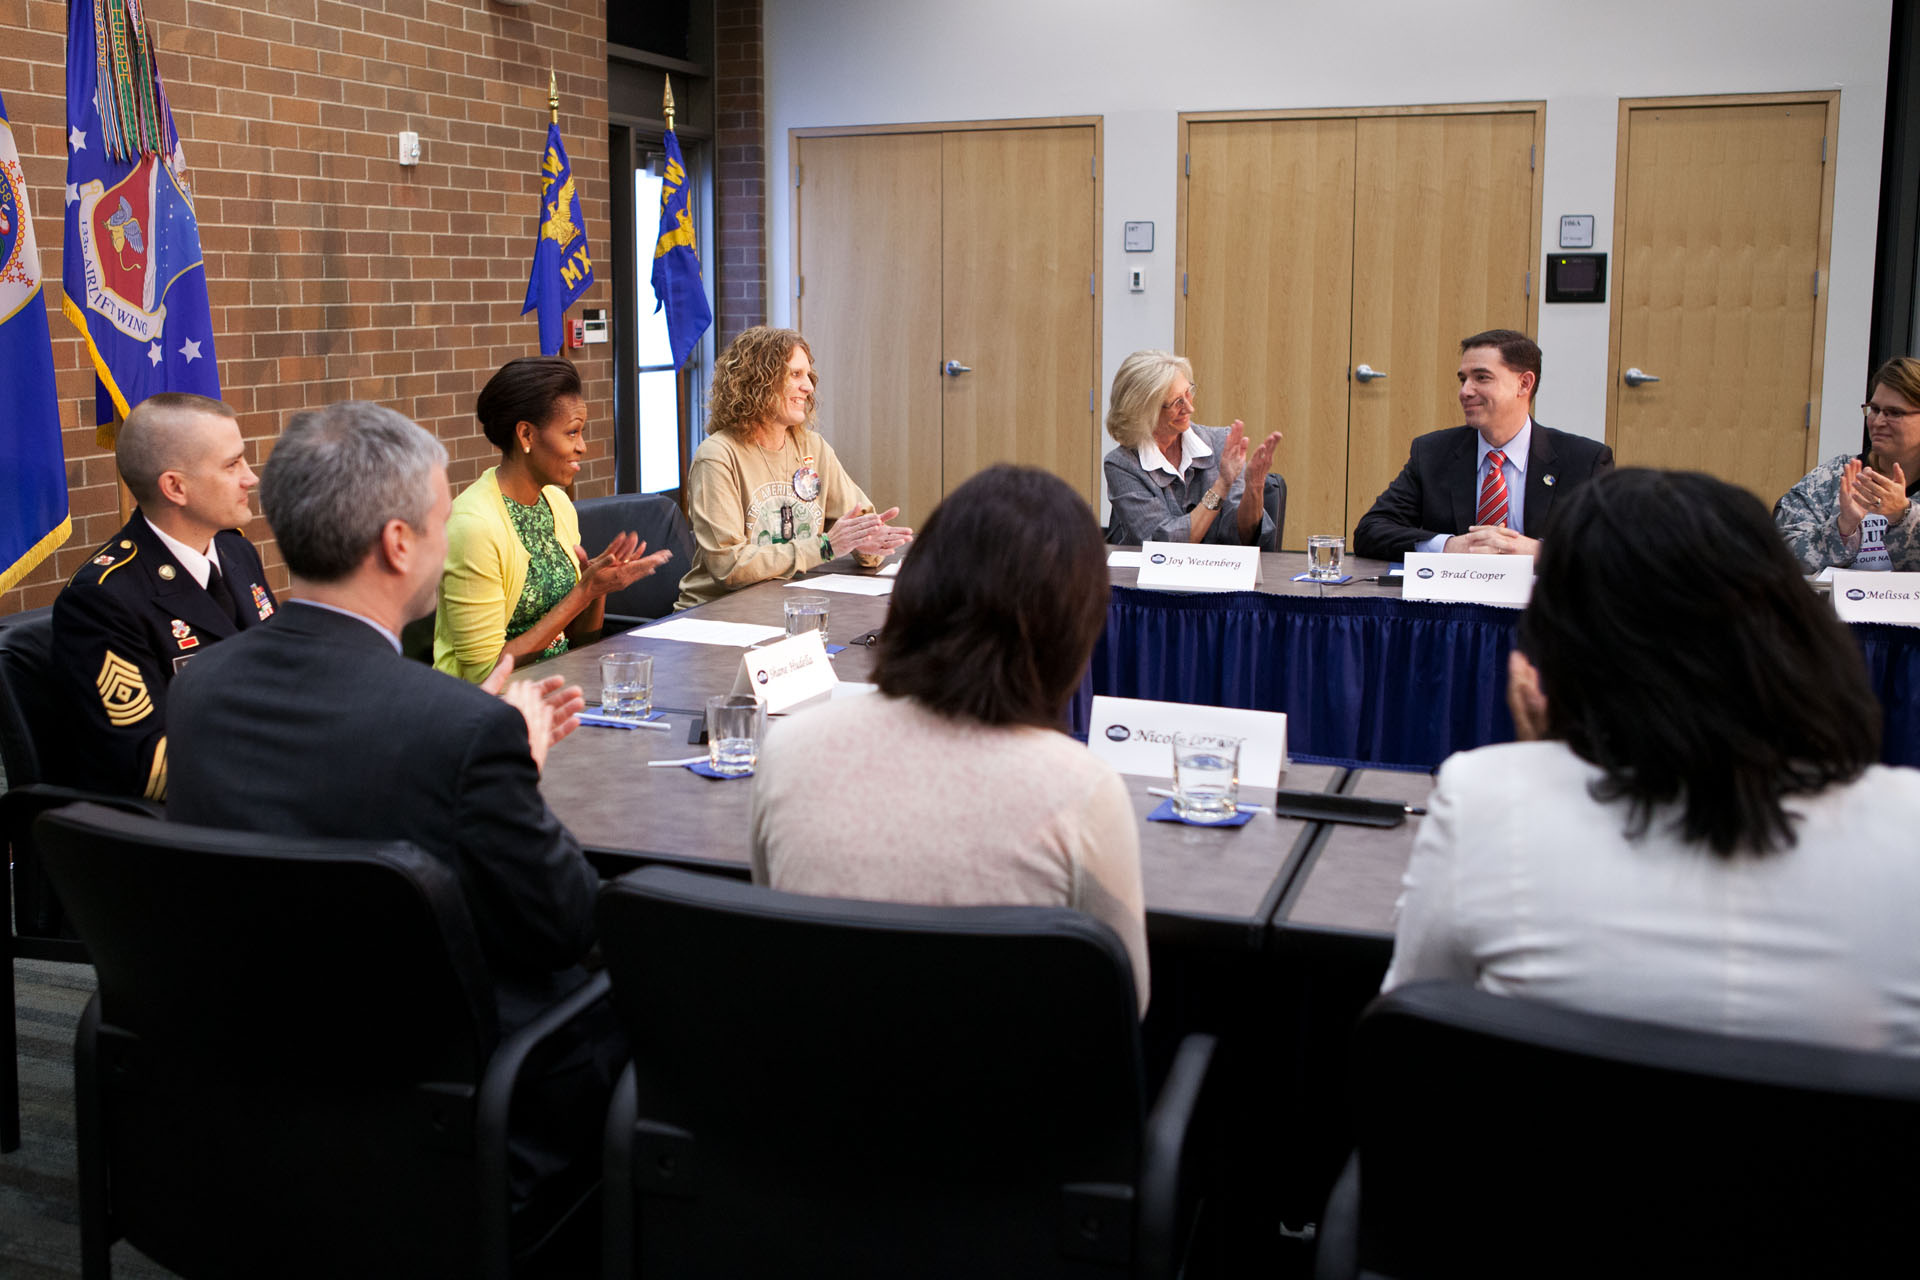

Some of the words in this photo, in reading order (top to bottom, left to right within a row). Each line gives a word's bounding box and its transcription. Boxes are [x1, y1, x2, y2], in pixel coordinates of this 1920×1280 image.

[111, 9, 131, 84] EUROPE
[84, 258, 116, 315] AIRLIFT
[115, 310, 148, 336] WING
[1166, 556, 1184, 567] Joy
[1187, 556, 1242, 570] Westenberg
[1440, 569, 1469, 579] Brad
[1469, 570, 1506, 582] Cooper
[1866, 589, 1910, 600] Melissa
